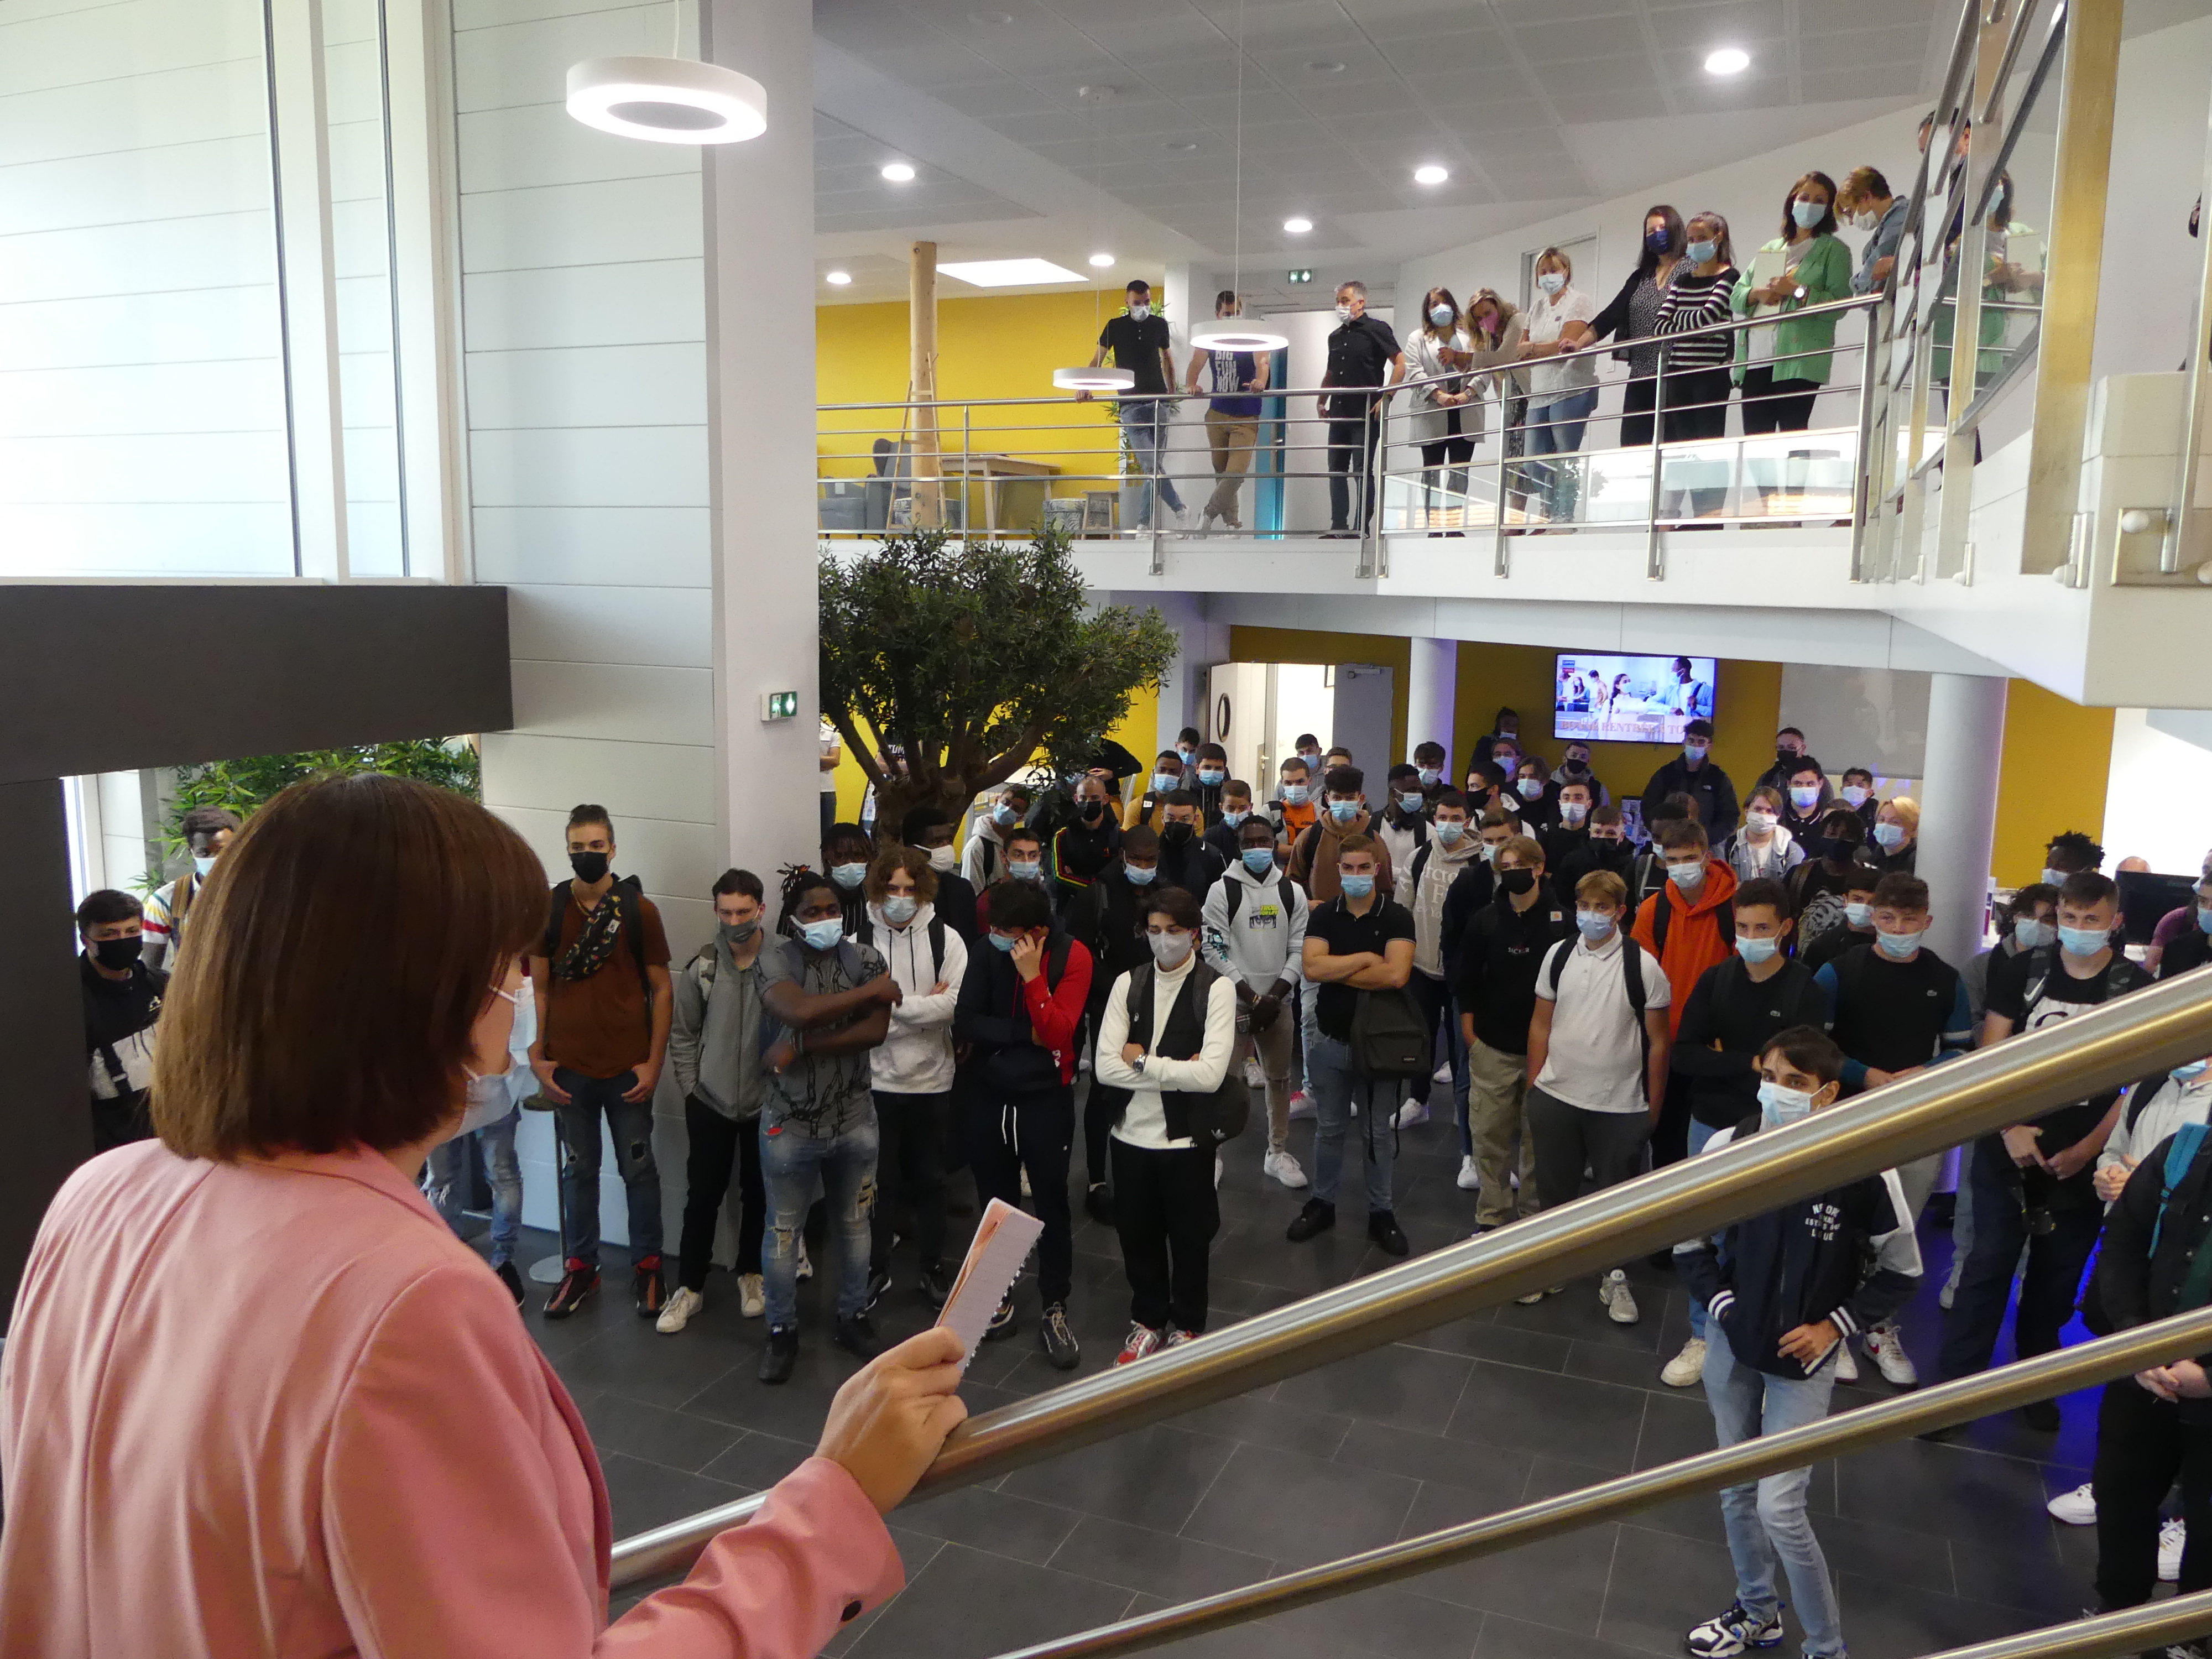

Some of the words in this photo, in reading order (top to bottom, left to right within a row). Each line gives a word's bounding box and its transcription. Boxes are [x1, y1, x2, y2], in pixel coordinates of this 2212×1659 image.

[1215, 350, 1233, 361] BIG
[1215, 360, 1237, 376] FUN
[1217, 376, 1239, 392] NOW
